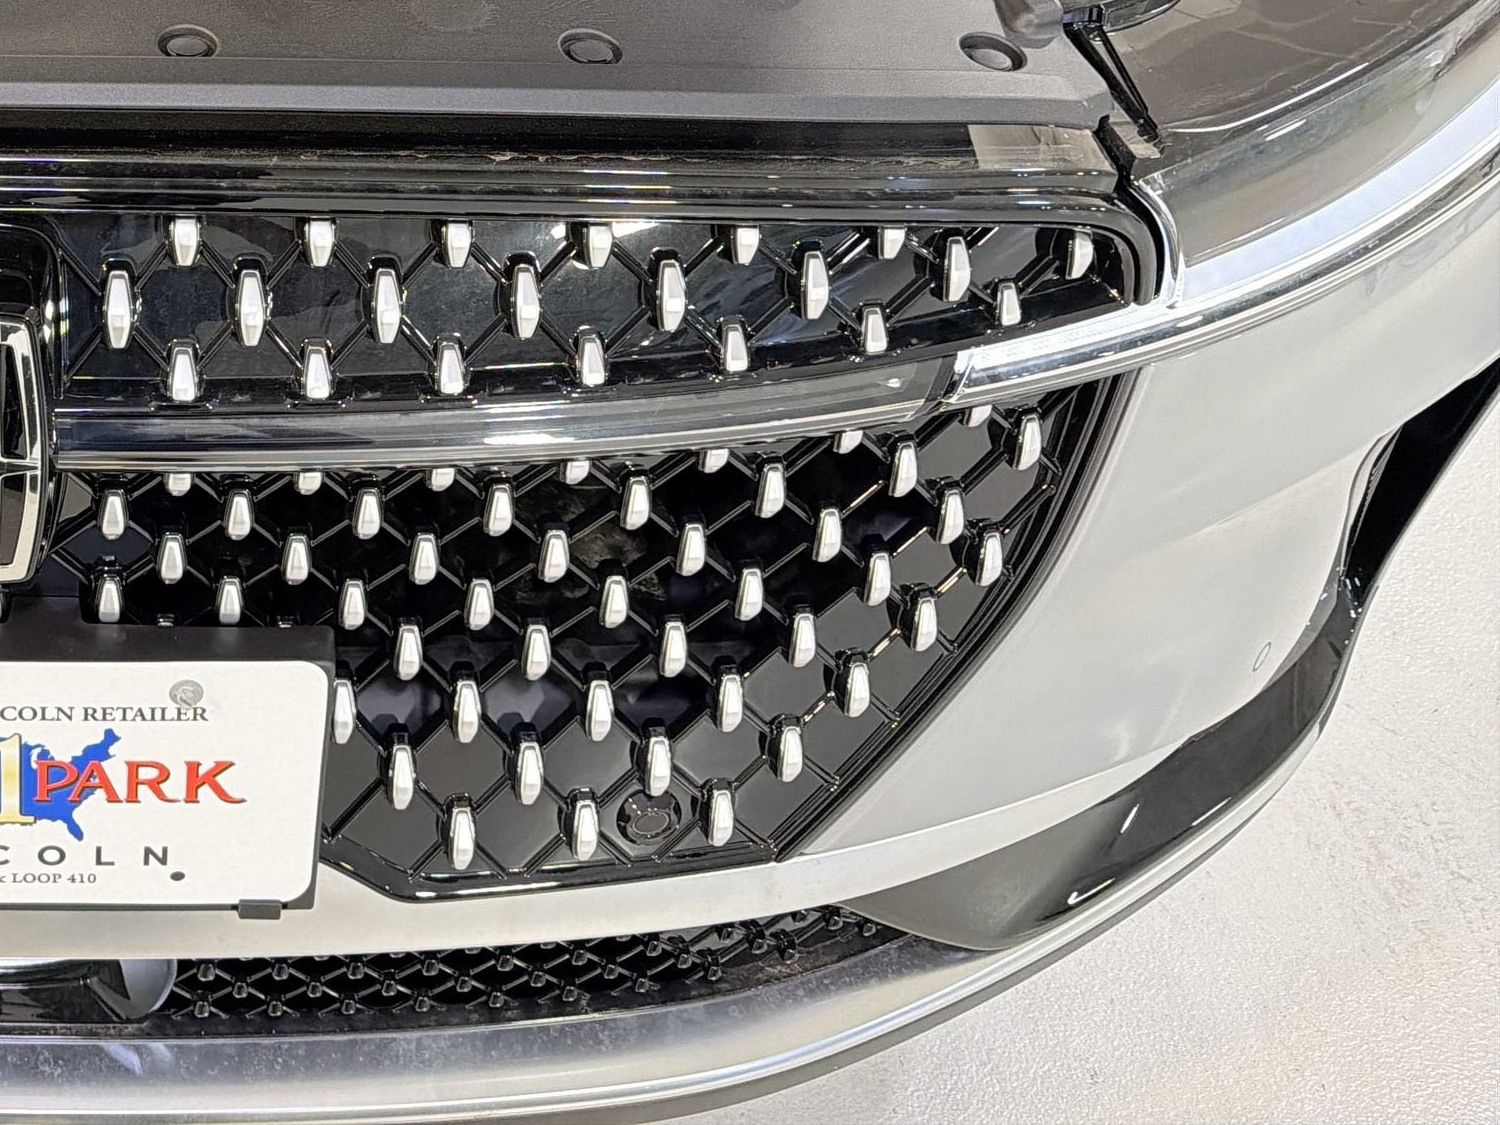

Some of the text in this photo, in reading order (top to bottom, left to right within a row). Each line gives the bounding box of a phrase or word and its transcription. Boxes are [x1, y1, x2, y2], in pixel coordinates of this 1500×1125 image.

[82, 706, 209, 723] RETAILER
[34, 760, 248, 804] PARK
[12, 872, 63, 884] LOOP
[67, 872, 98, 884] 410
